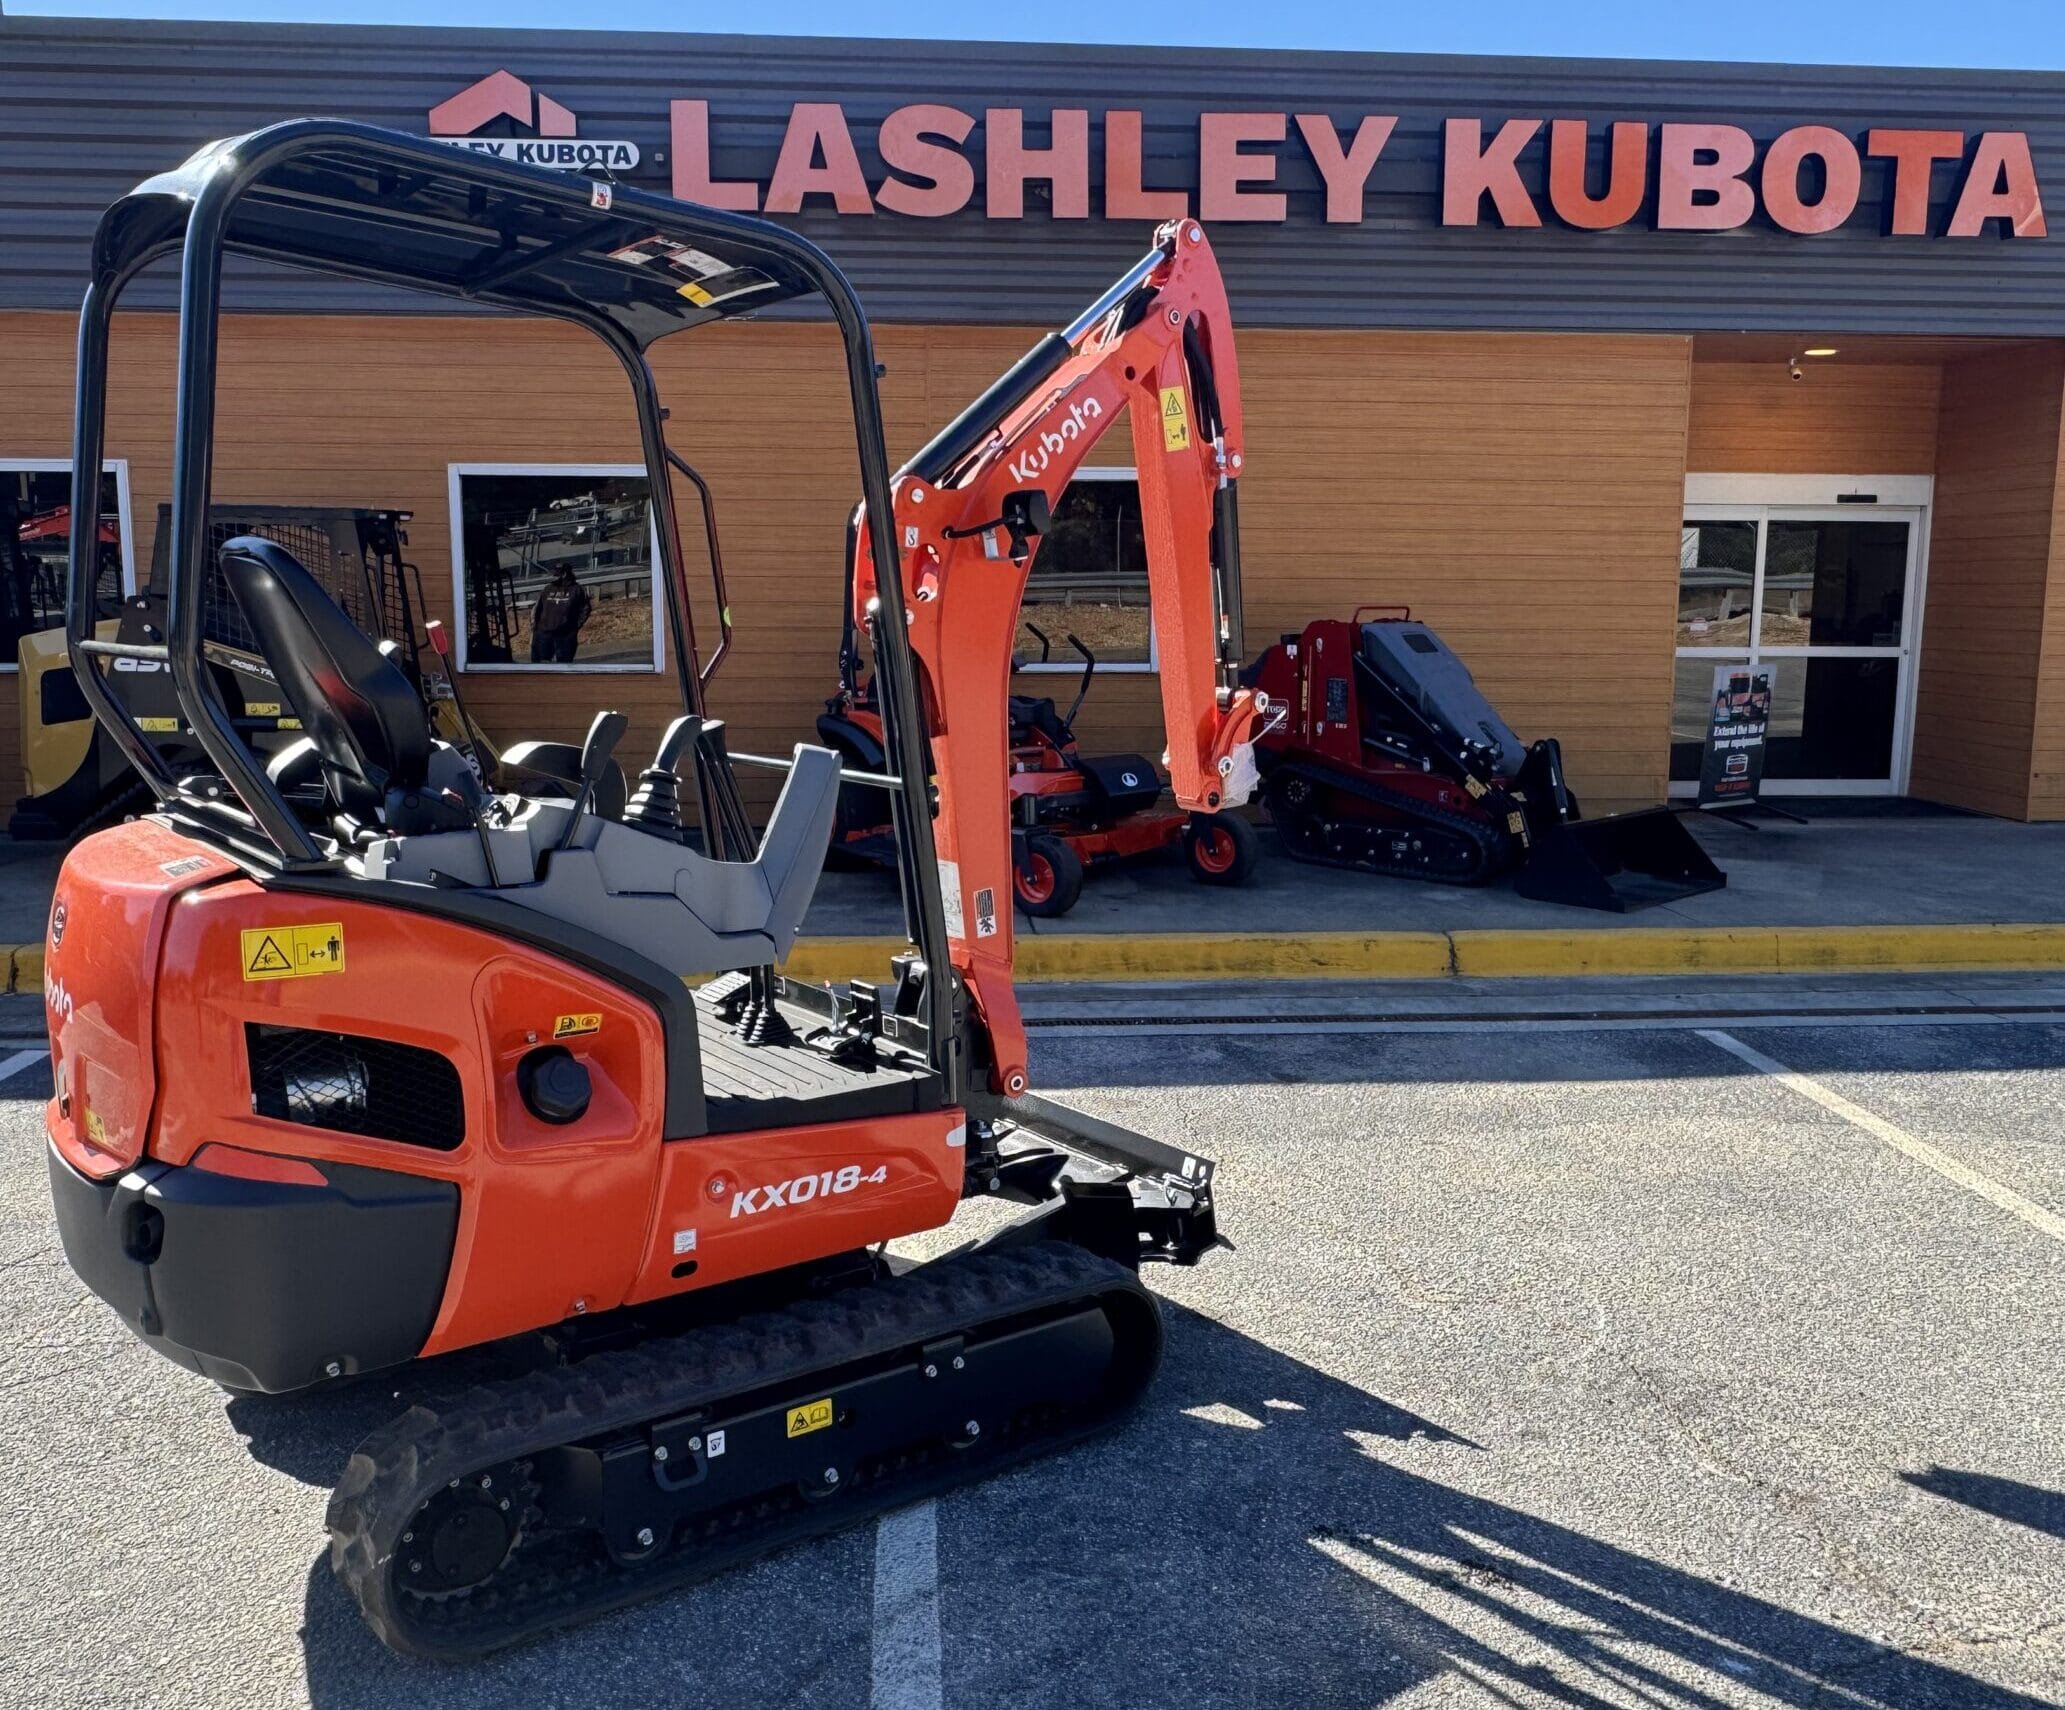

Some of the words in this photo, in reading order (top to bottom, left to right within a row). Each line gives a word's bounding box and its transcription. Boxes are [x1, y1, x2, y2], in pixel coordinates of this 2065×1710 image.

[517, 143, 632, 165] KUBOTA
[670, 99, 1399, 223] LASHLEY
[1442, 118, 2048, 237] KUBOTA
[1008, 397, 1103, 484] Kubota
[729, 1165, 887, 1218] KX018-4
